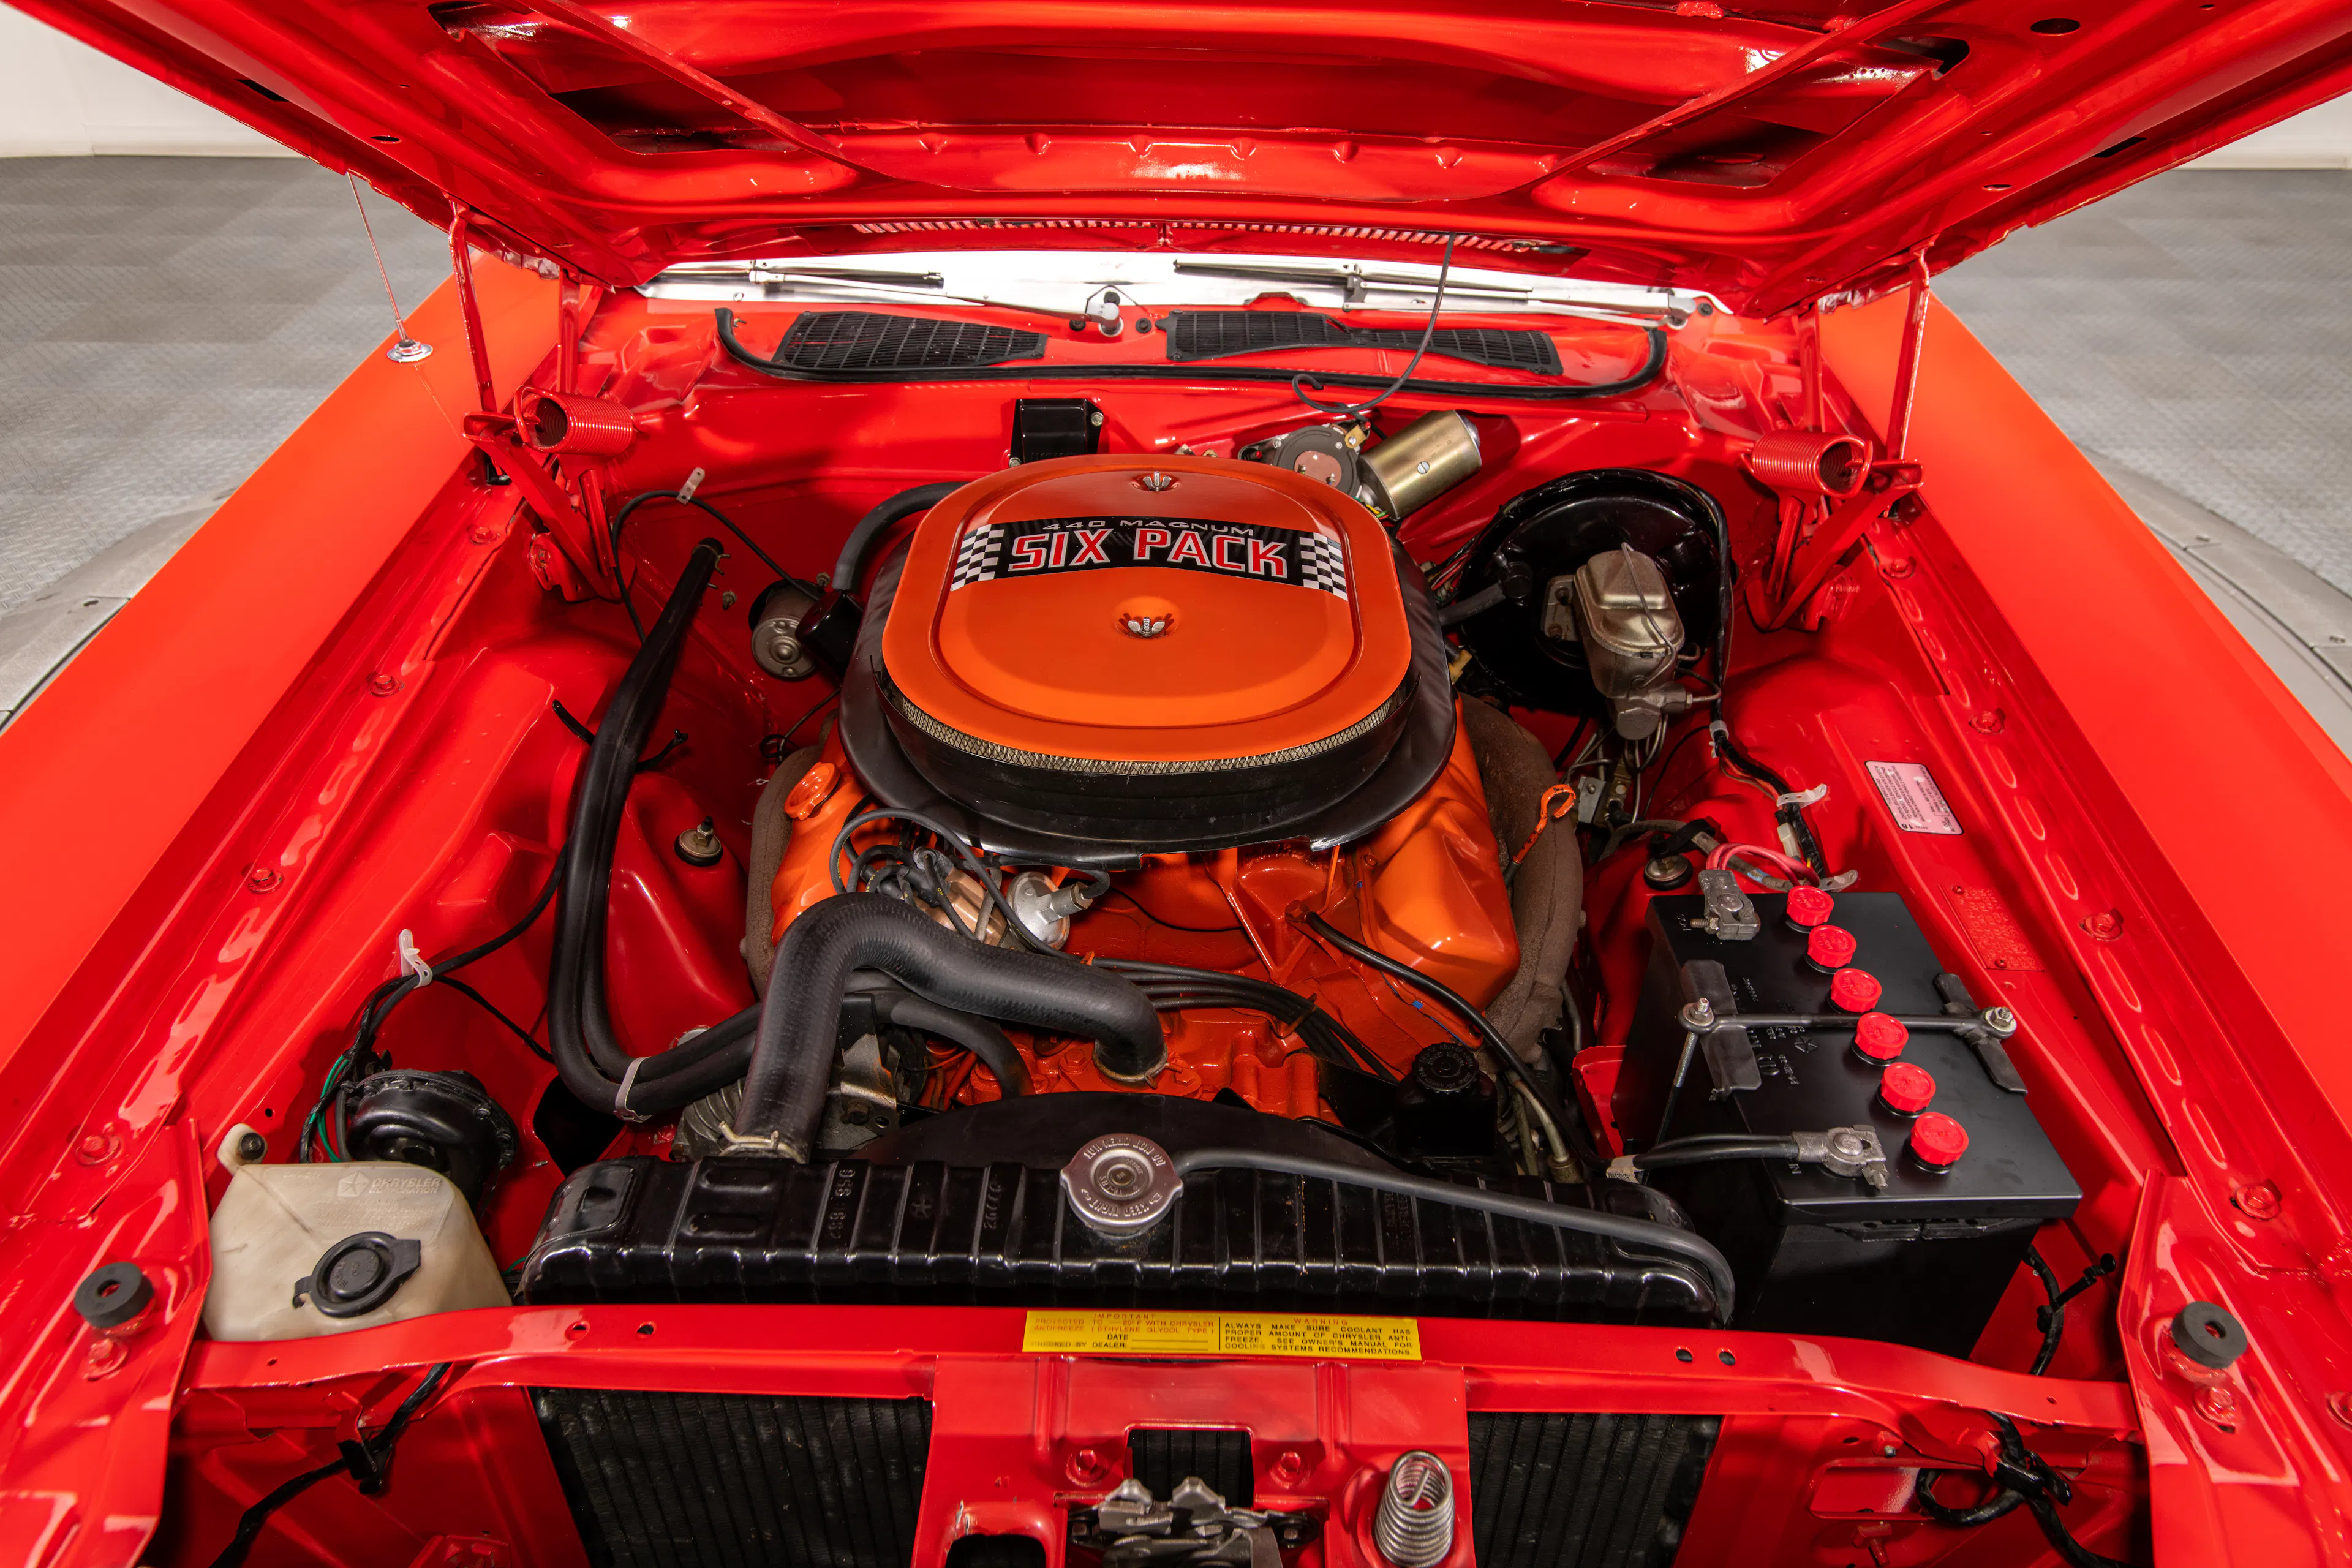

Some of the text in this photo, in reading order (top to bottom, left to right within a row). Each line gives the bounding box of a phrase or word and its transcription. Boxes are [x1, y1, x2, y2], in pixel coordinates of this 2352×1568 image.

[1042, 520, 1254, 536] 440 MAGNUM
[1008, 527, 1288, 579] SIX PACK
[1104, 1137, 1130, 1148] OPEN
[1133, 1139, 1154, 1156] NOT
[1083, 1144, 1102, 1160] HOT
[1152, 1153, 1166, 1167] DO
[371, 1177, 442, 1188] CHRYSLER
[1088, 1199, 1150, 1217] KEEP TIGHT
[1319, 1346, 1413, 1355] RECOMMENDATIONS.
